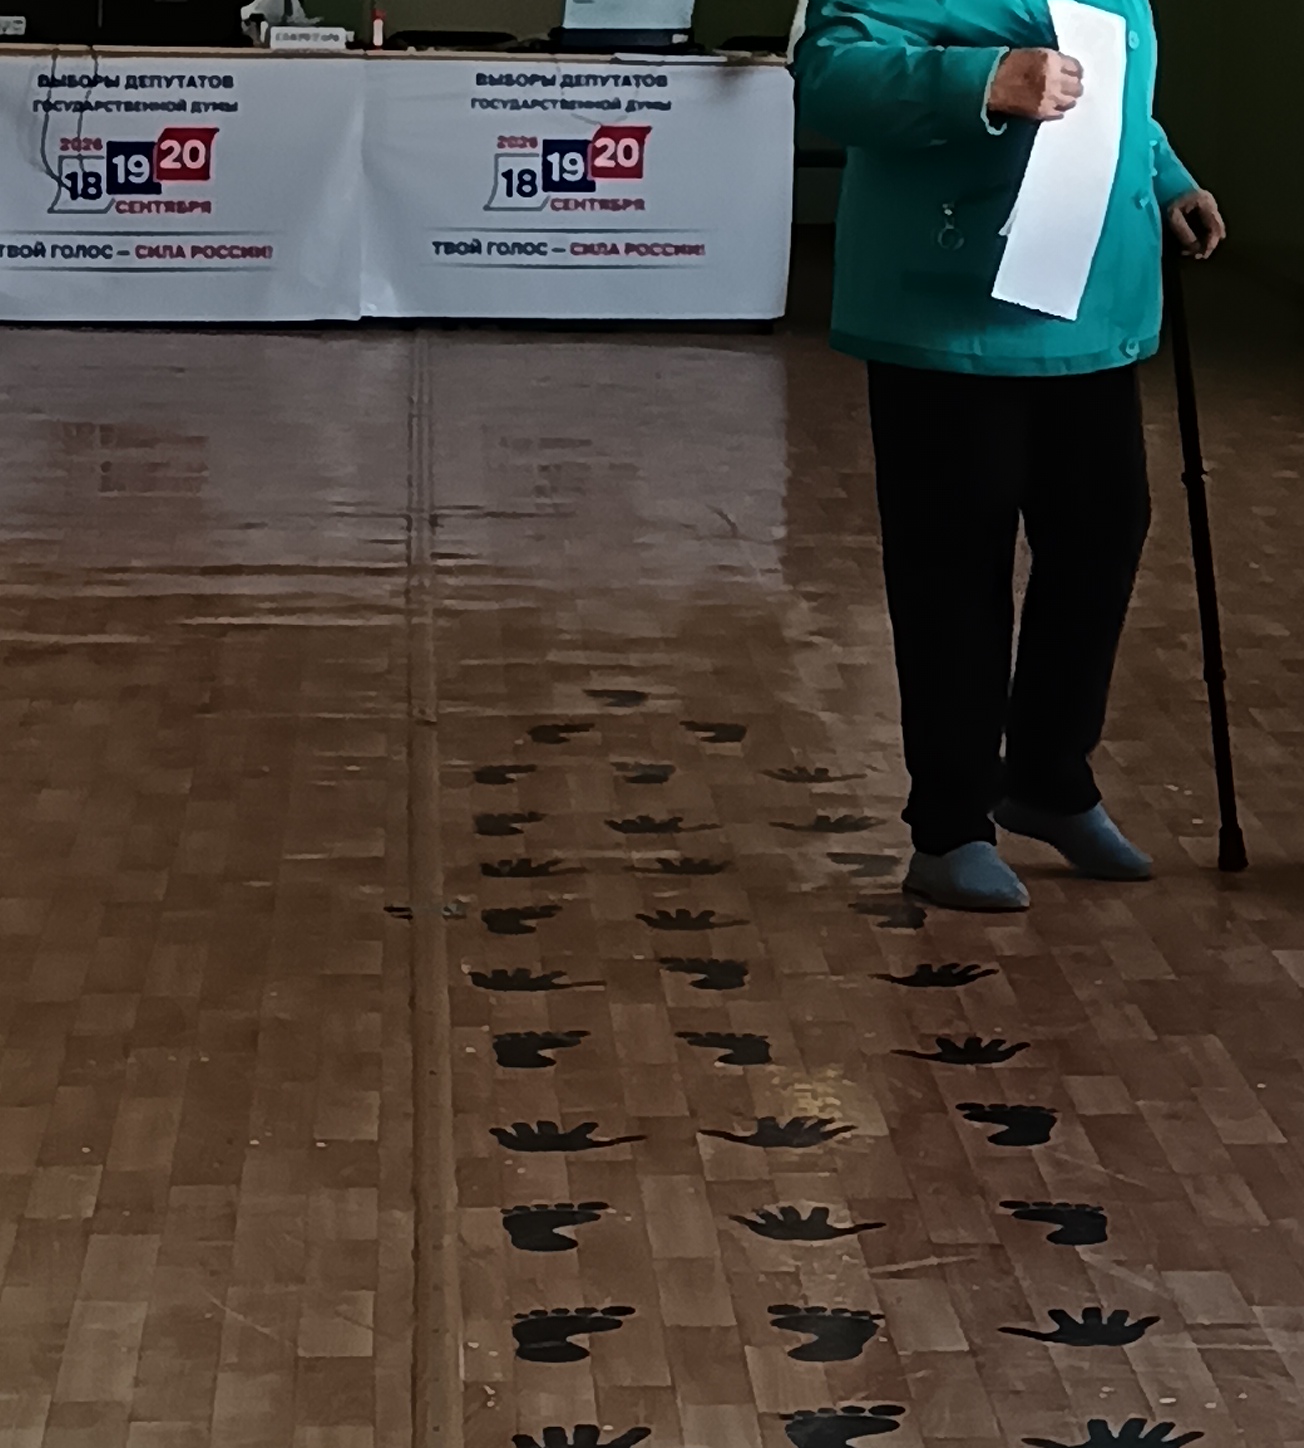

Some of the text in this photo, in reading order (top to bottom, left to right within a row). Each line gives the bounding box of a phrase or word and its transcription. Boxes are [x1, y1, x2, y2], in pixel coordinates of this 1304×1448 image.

[38, 75, 234, 89] ВЫБОРЫ ДЕПУТАТОВ
[476, 73, 668, 88] ВЫБОРЫ ДЕПУТАТОВ
[65, 139, 206, 200] 18 19 20
[501, 138, 638, 197] 18 19 20
[115, 201, 211, 214] СЕНТЯБРЯ
[550, 198, 645, 211] СЕНТЯБРЯ
[51, 244, 113, 259] ГОЛОС
[135, 245, 185, 259] СИЛА
[432, 239, 481, 255] ТВОЙ
[487, 241, 548, 256] ГОЛОС
[570, 243, 620, 256] СИЛА
